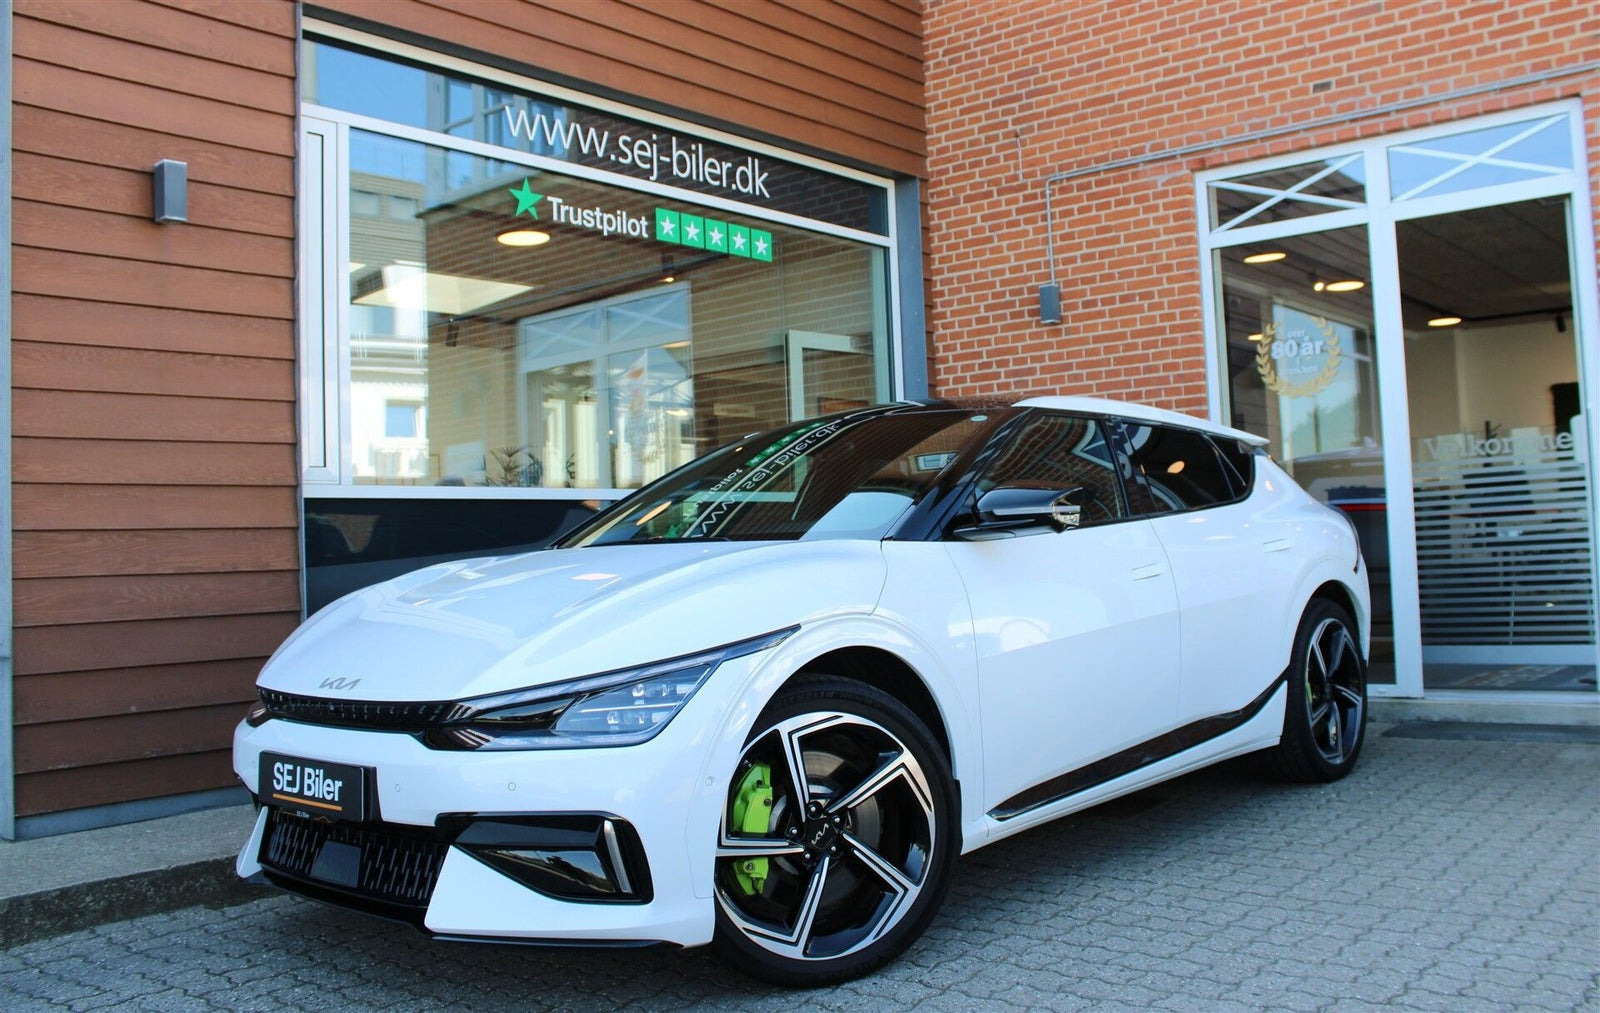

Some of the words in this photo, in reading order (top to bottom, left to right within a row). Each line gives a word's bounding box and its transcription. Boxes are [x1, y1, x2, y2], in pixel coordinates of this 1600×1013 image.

[505, 105, 770, 198] www.sej-biler.dk
[547, 196, 649, 238] Trustpilot
[1271, 339, 1298, 360] 80
[1301, 336, 1324, 355] år
[272, 761, 301, 794] SEJ
[303, 767, 343, 801] Biler
